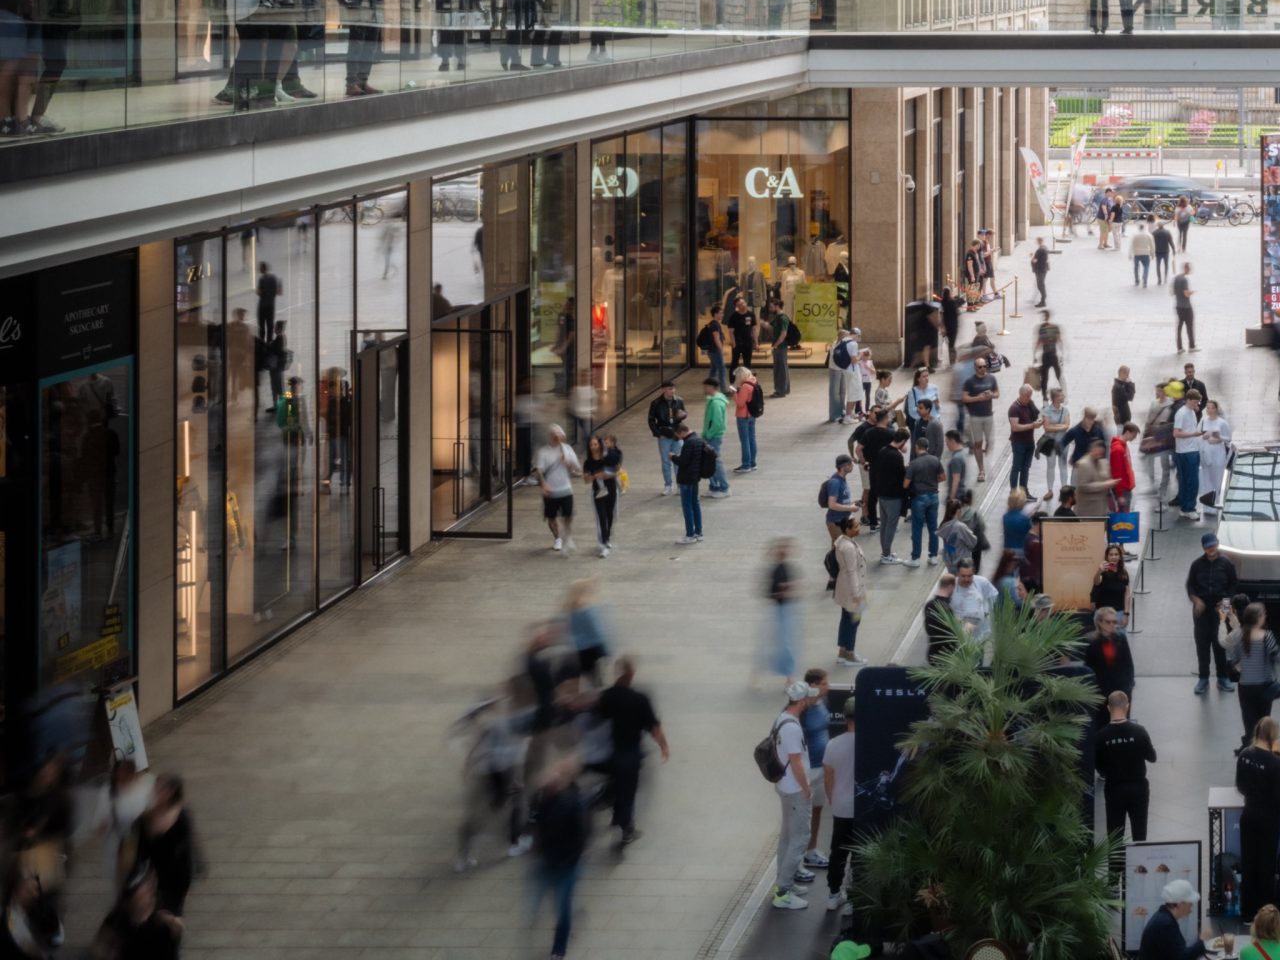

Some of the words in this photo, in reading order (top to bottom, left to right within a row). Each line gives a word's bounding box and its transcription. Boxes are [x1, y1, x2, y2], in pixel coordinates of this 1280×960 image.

[745, 167, 804, 199] C&A
[65, 304, 109, 321] APOTHECARY
[797, 303, 836, 317] -50%
[69, 319, 104, 336] SKINCARE
[1106, 737, 1135, 745] TESLA
